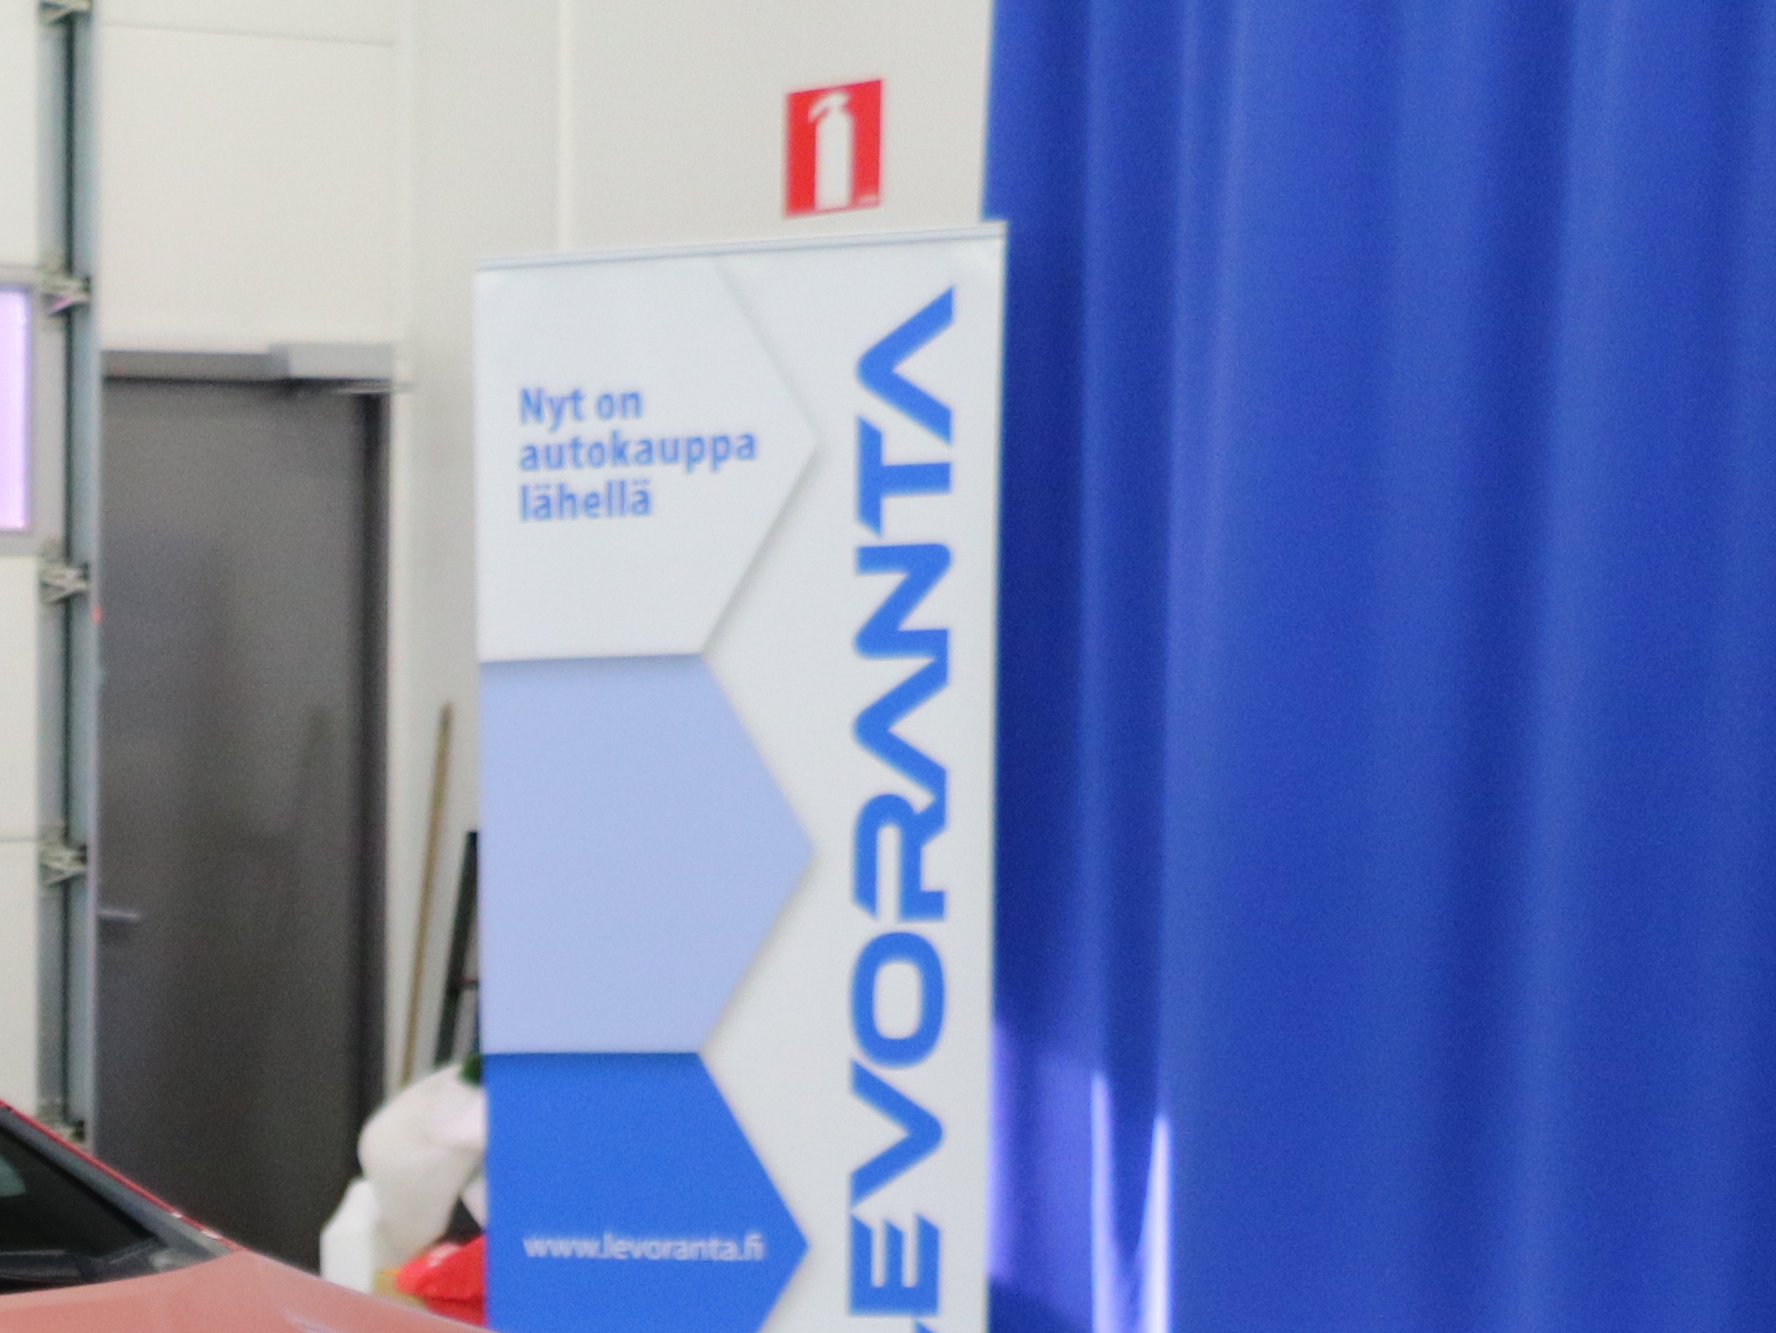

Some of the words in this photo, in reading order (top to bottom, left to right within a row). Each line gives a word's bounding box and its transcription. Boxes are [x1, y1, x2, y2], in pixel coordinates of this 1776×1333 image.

[520, 388, 585, 433] Nyt
[596, 391, 644, 420] on
[519, 429, 758, 475] autokauppa
[520, 478, 653, 522] lähellä
[523, 1233, 765, 1262] www.levoranta.fi
